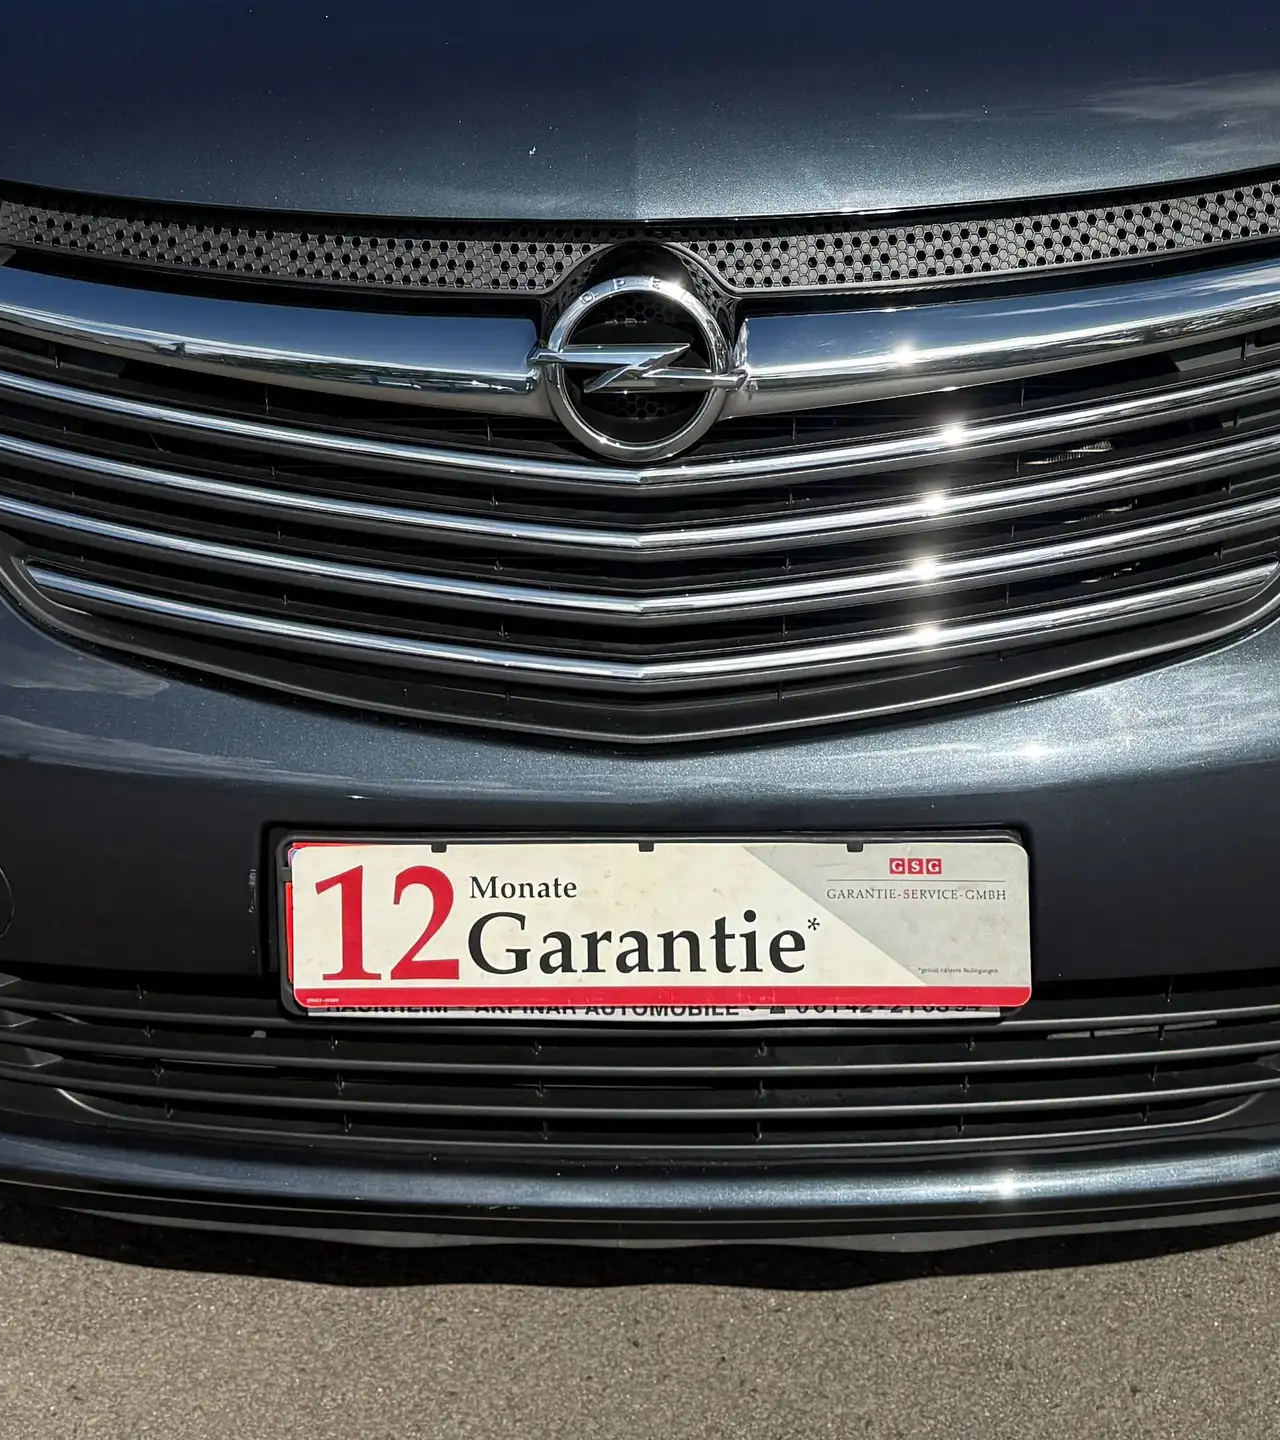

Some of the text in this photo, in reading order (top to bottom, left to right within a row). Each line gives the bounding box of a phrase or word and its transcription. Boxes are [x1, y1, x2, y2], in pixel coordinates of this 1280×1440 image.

[890, 859, 941, 874] GSG
[827, 888, 1007, 901] GARANTIE-SERVICE-GMBH
[315, 864, 577, 981] 12 Monate
